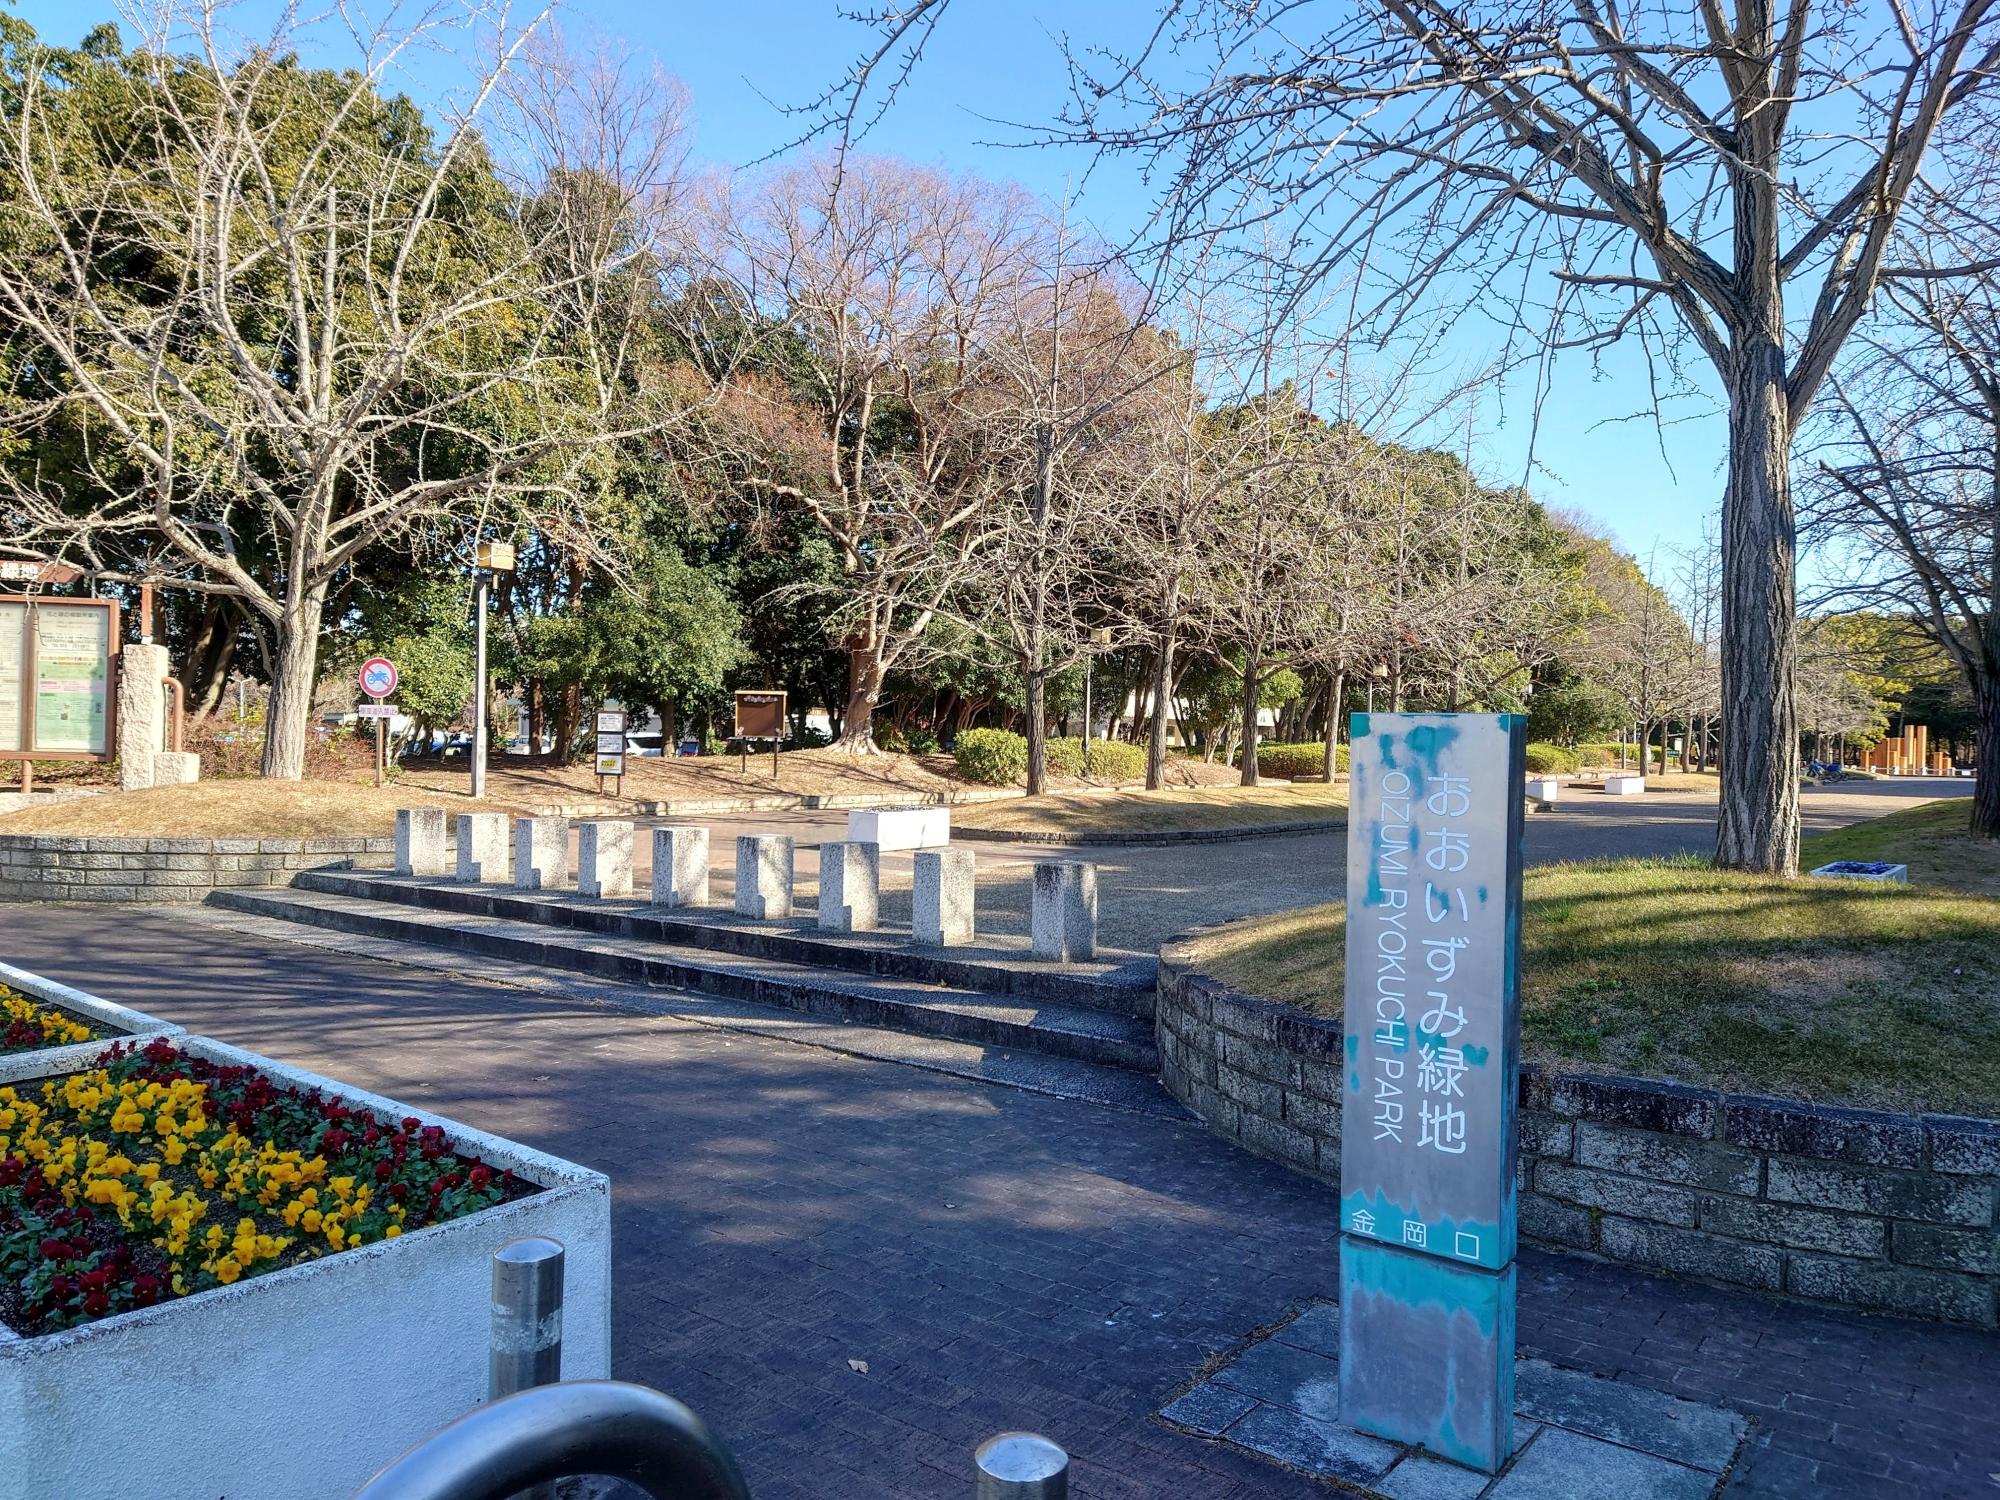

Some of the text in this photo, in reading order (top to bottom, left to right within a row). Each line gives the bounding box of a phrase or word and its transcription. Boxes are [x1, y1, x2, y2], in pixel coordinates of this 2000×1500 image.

[1373, 771, 1411, 1144] OIZUMI RYOKUCHI PARK
[1416, 772, 1472, 1155] おおいずみ緑地
